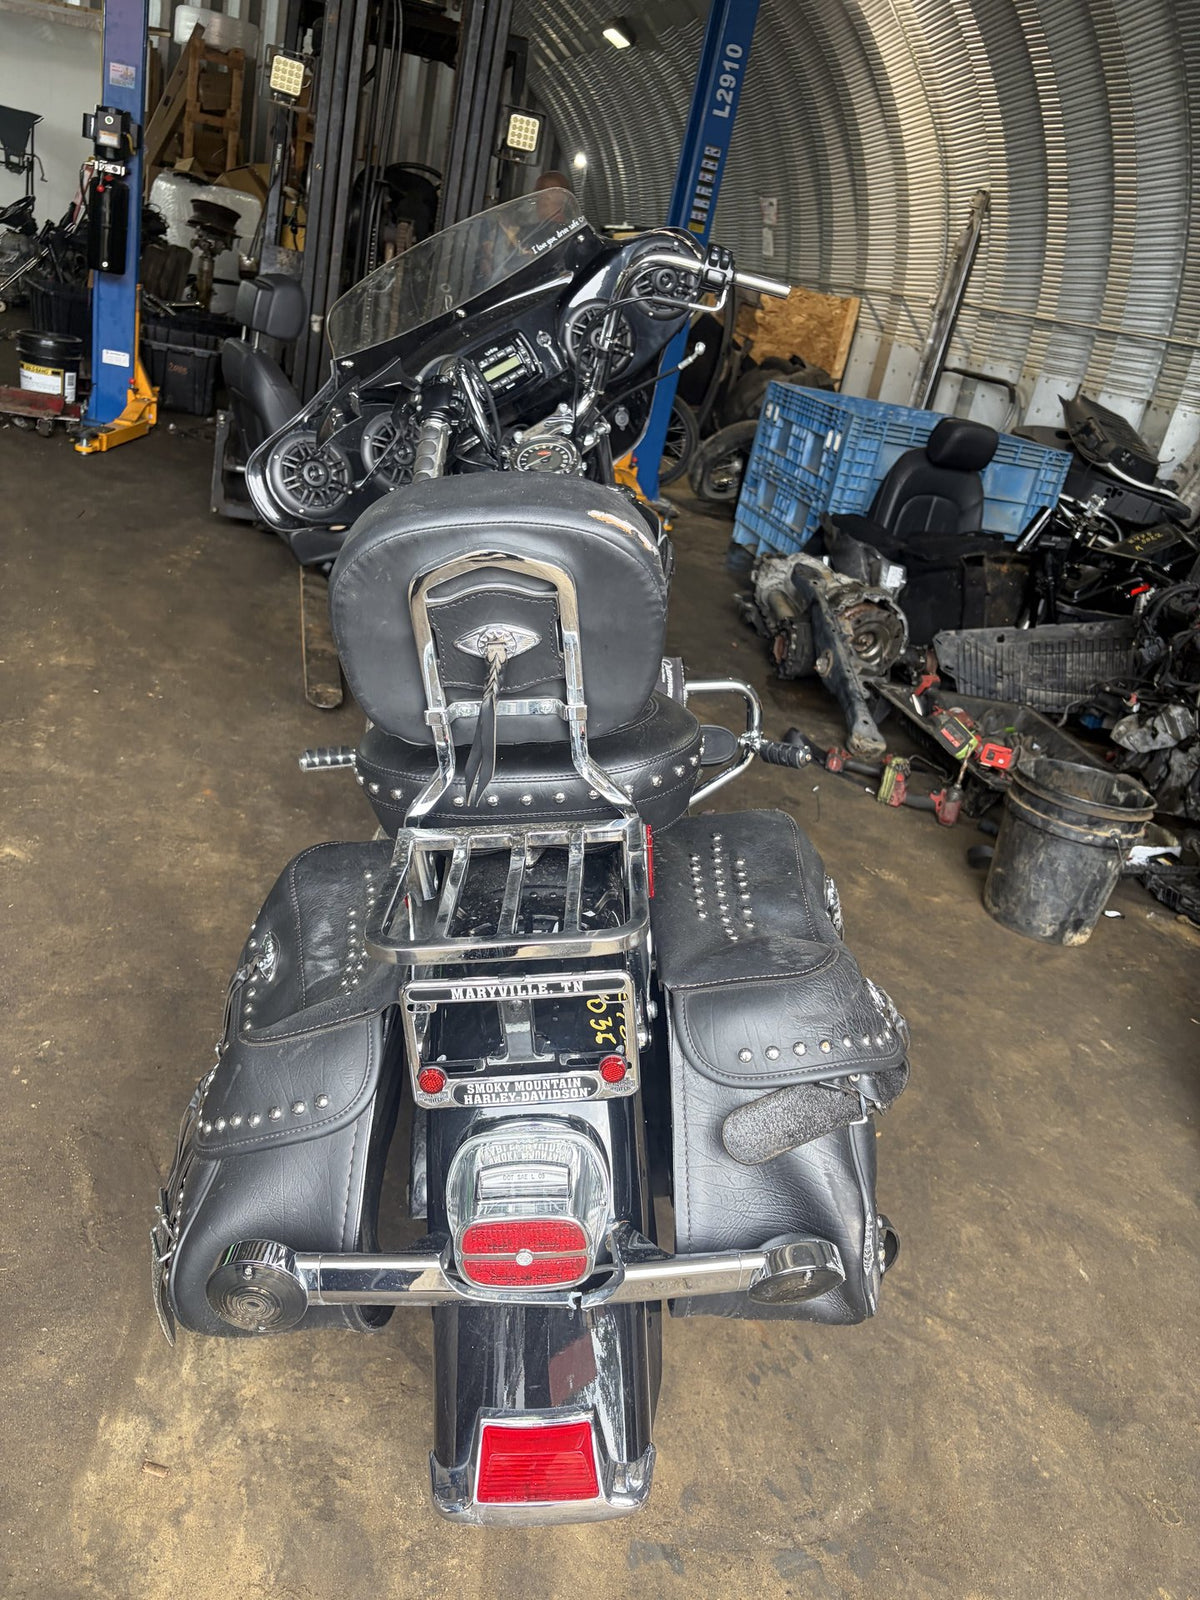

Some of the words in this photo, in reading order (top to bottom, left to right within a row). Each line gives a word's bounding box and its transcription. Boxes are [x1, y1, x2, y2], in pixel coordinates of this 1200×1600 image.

[712, 44, 743, 118] L2910
[561, 981, 584, 994] TN
[466, 1081, 509, 1094] SMOKY
[514, 1077, 581, 1091] MOUNTAIN
